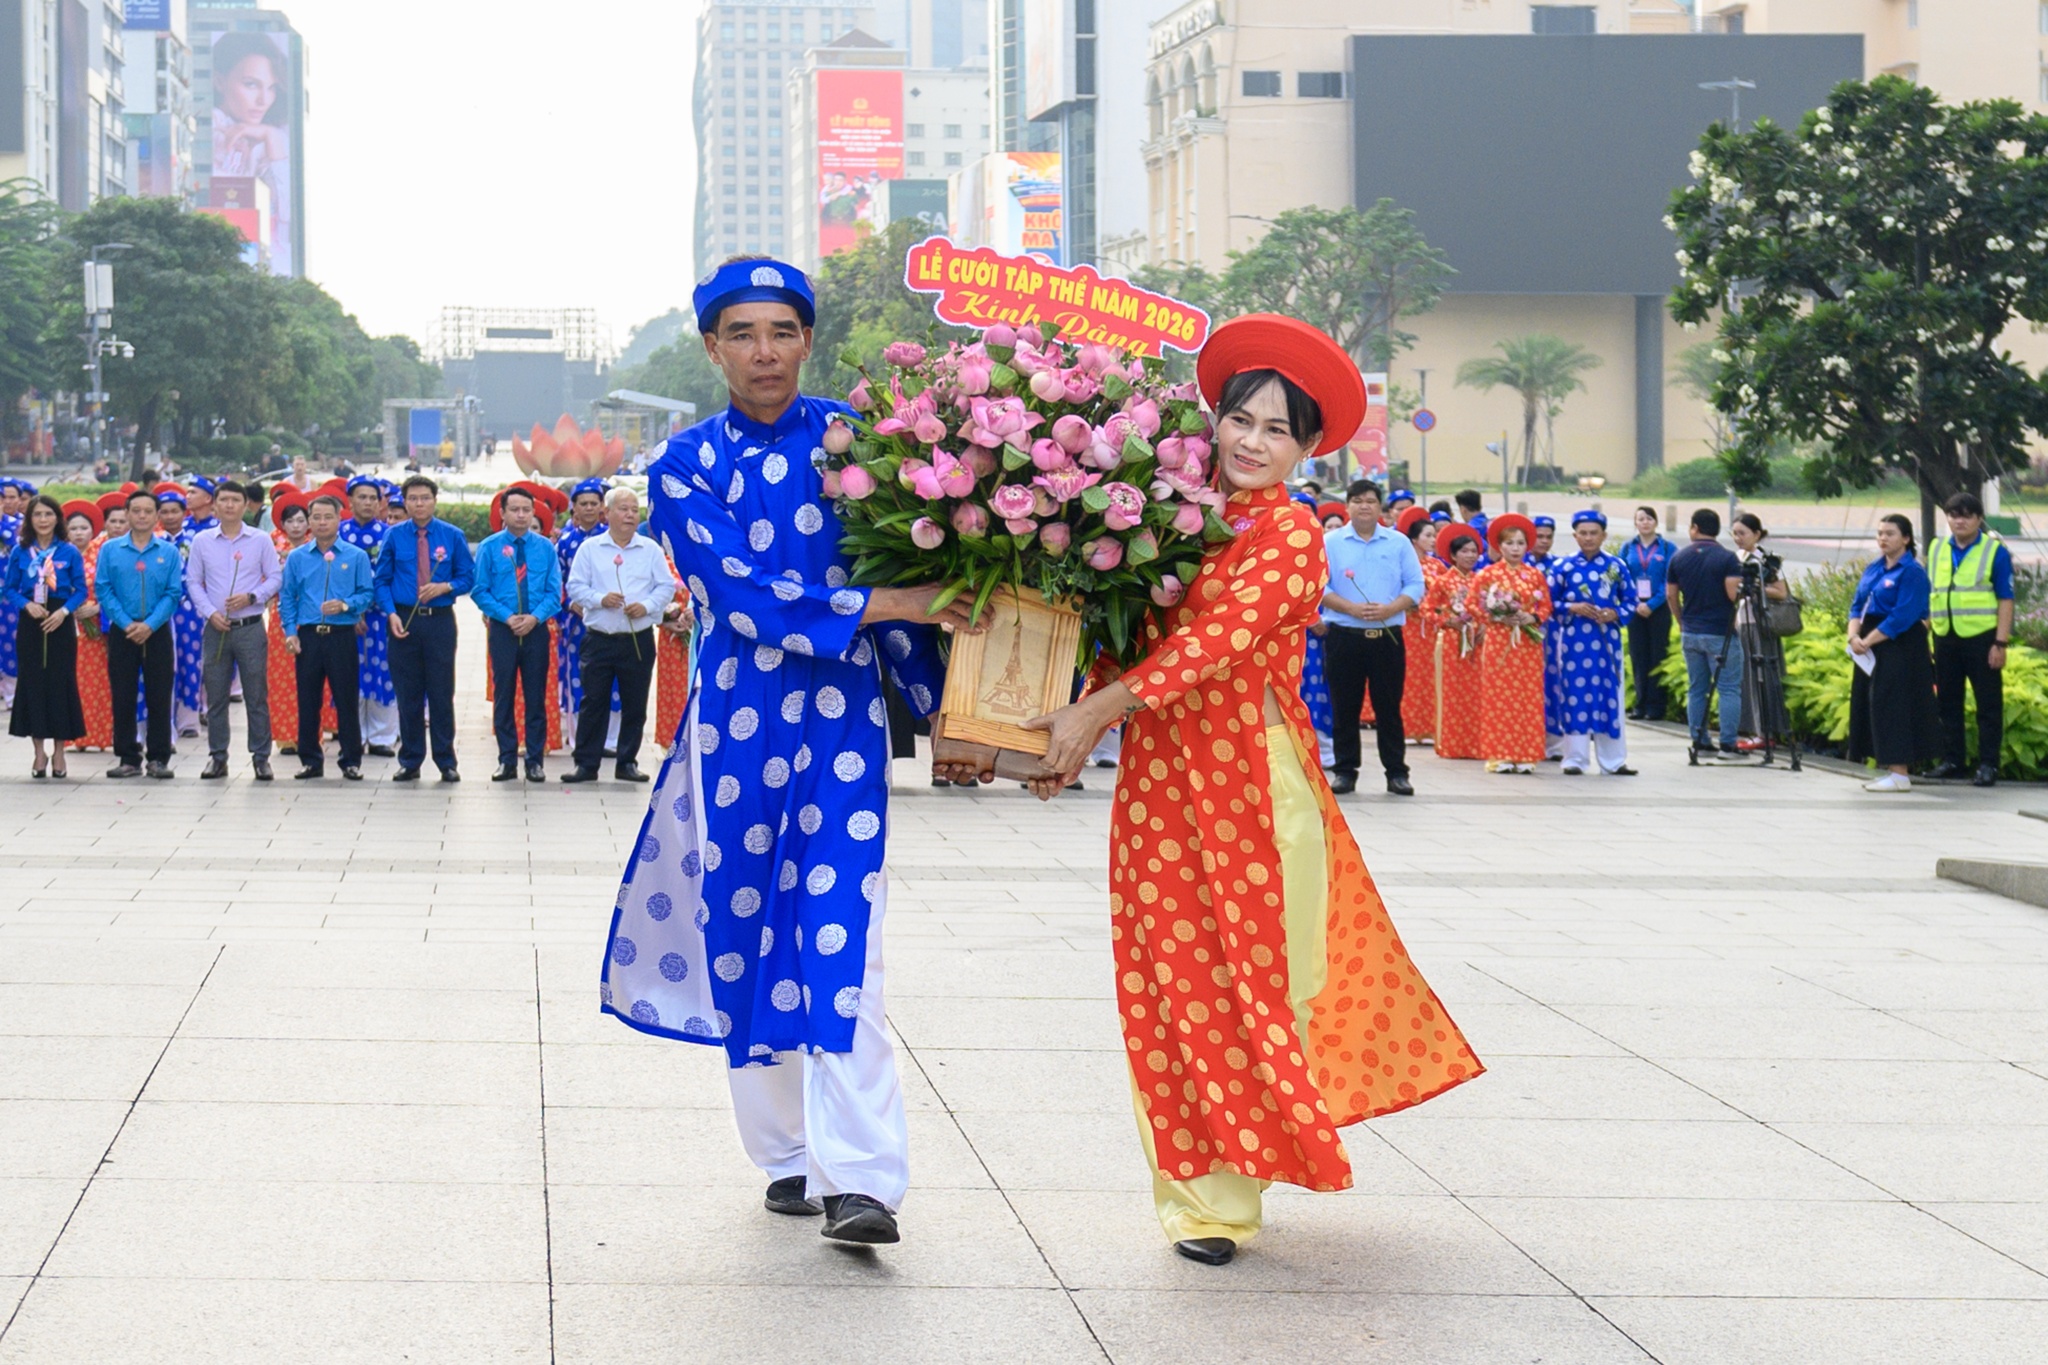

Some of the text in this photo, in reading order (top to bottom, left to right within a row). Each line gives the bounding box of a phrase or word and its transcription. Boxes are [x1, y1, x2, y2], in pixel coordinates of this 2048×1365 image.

[918, 246, 1196, 342] LỄ CƯỚI TẬP THỂ NĂM 2026
[949, 290, 1041, 326] Kính
